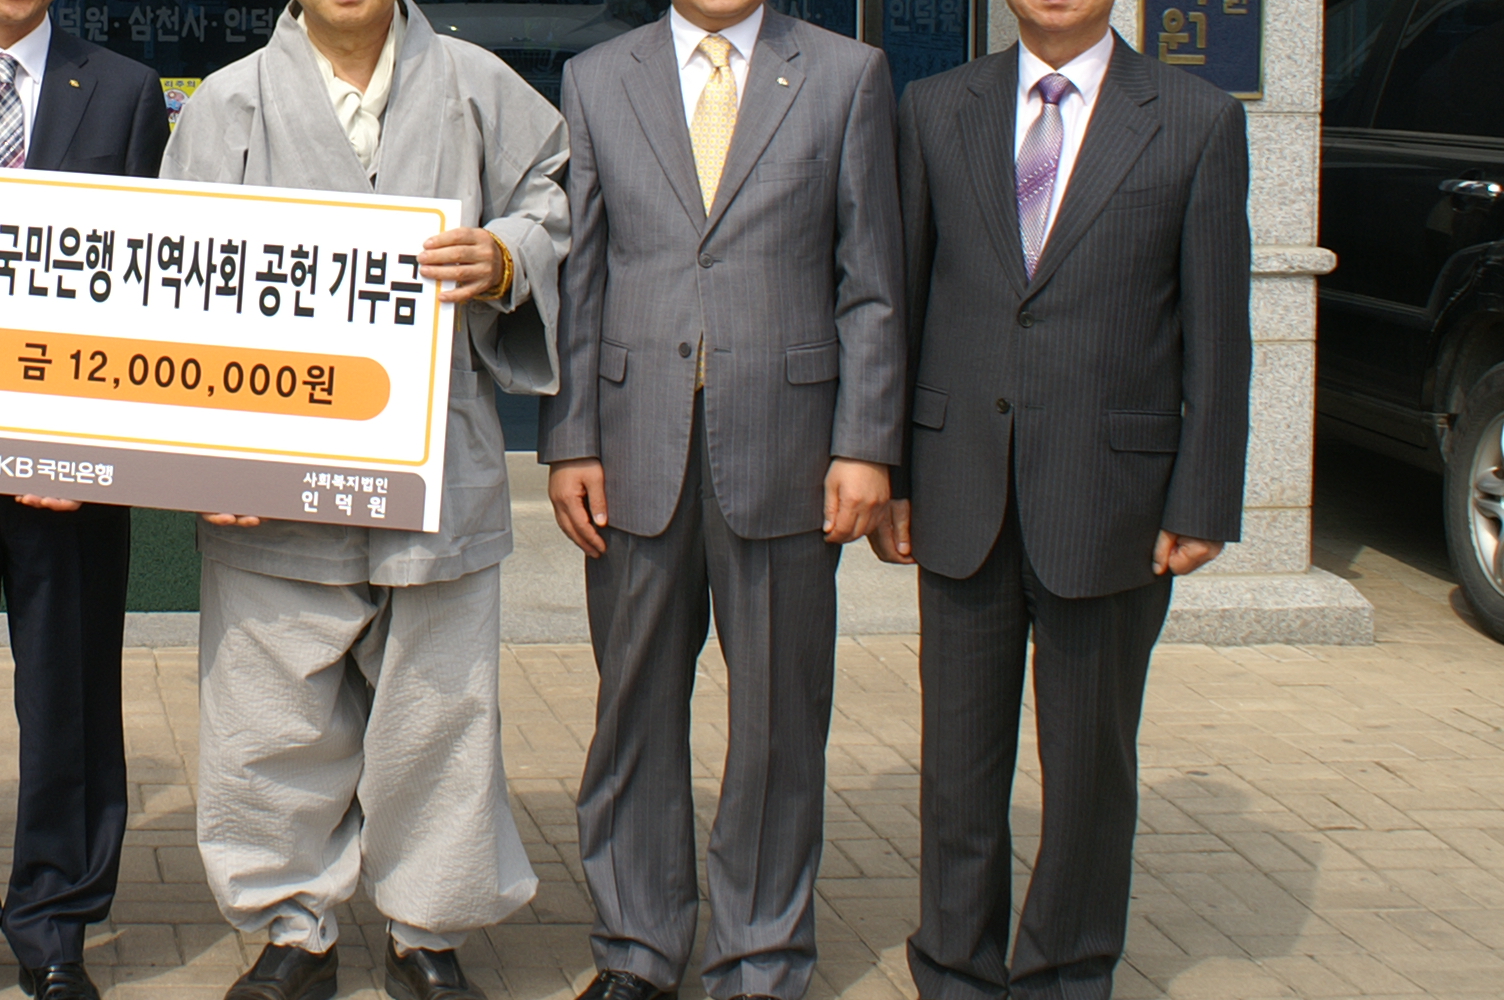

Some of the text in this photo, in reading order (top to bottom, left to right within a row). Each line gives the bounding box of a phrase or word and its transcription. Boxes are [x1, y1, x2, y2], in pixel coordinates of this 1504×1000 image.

[123, 233, 247, 314] 지역사회
[255, 244, 319, 318] 공헌
[329, 248, 423, 326] 기부금
[18, 342, 335, 406] 금 12,000,000원
[302, 471, 389, 494] 사회복지법인
